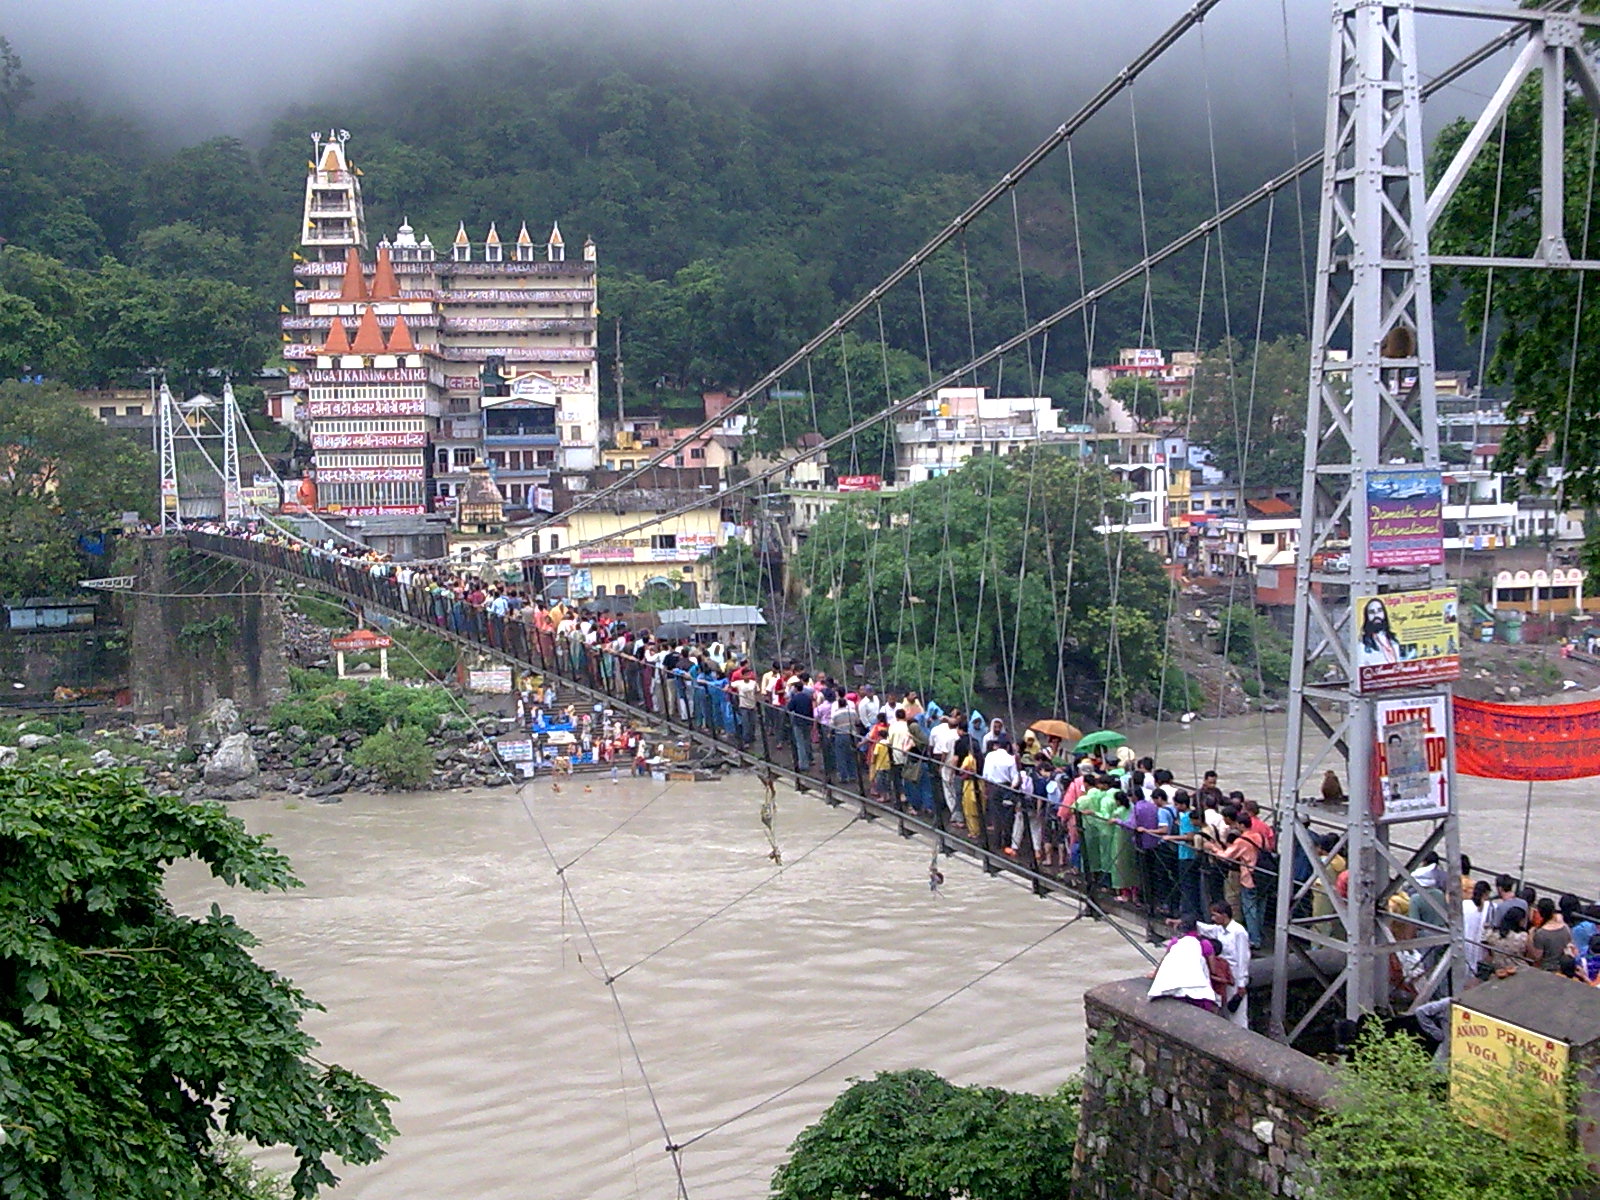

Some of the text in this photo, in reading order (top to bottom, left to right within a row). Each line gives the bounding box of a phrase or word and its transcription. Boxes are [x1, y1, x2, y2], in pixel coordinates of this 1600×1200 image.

[306, 368, 427, 382] YOGA TRAINING CENTRE
[1370, 502, 1441, 520] Domestic and
[1371, 520, 1440, 537] International
[1384, 597, 1401, 607] Yoga
[1456, 1024, 1558, 1070] ANAND PRAKASH
[1466, 1041, 1499, 1063] YOGA
